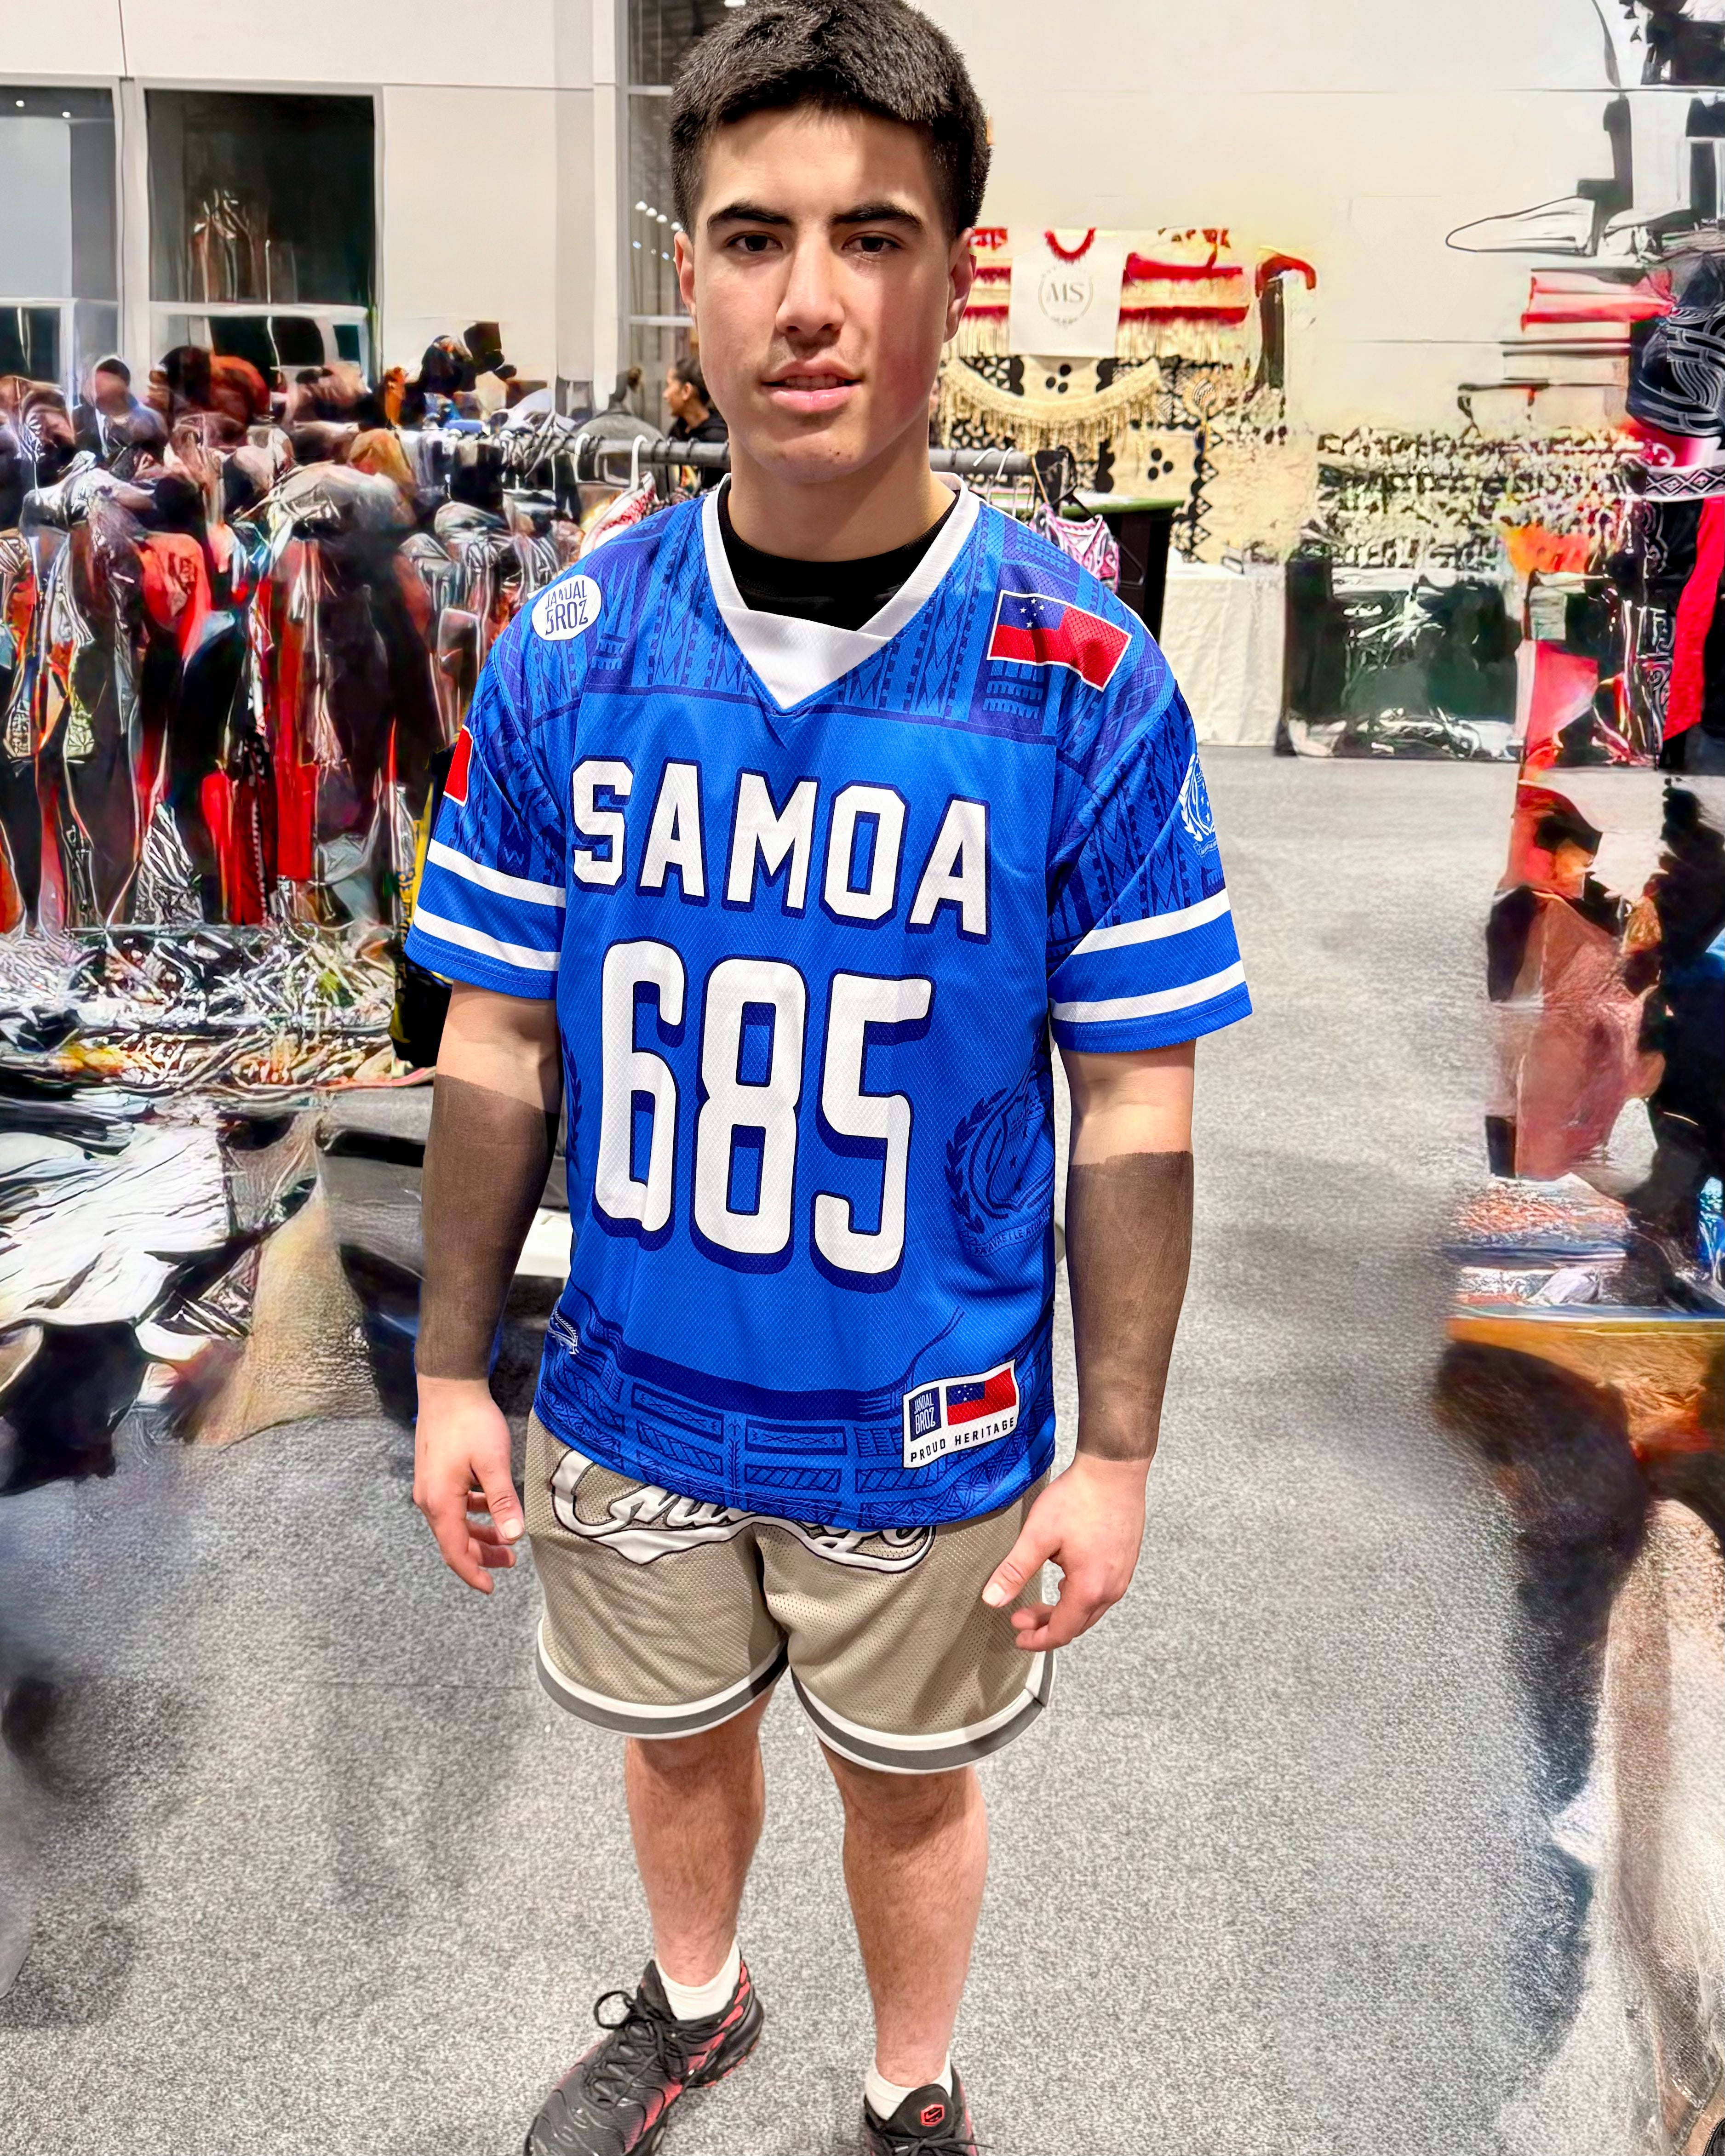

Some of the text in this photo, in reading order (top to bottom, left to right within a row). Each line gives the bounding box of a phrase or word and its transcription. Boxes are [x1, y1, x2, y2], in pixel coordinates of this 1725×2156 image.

[1046, 282, 1084, 302] MS
[571, 759, 989, 938] SAMOA
[593, 939, 934, 1277] 685
[911, 1417, 1014, 1462] PROUD HERITAGE
[915, 1407, 936, 1435] BROZ
